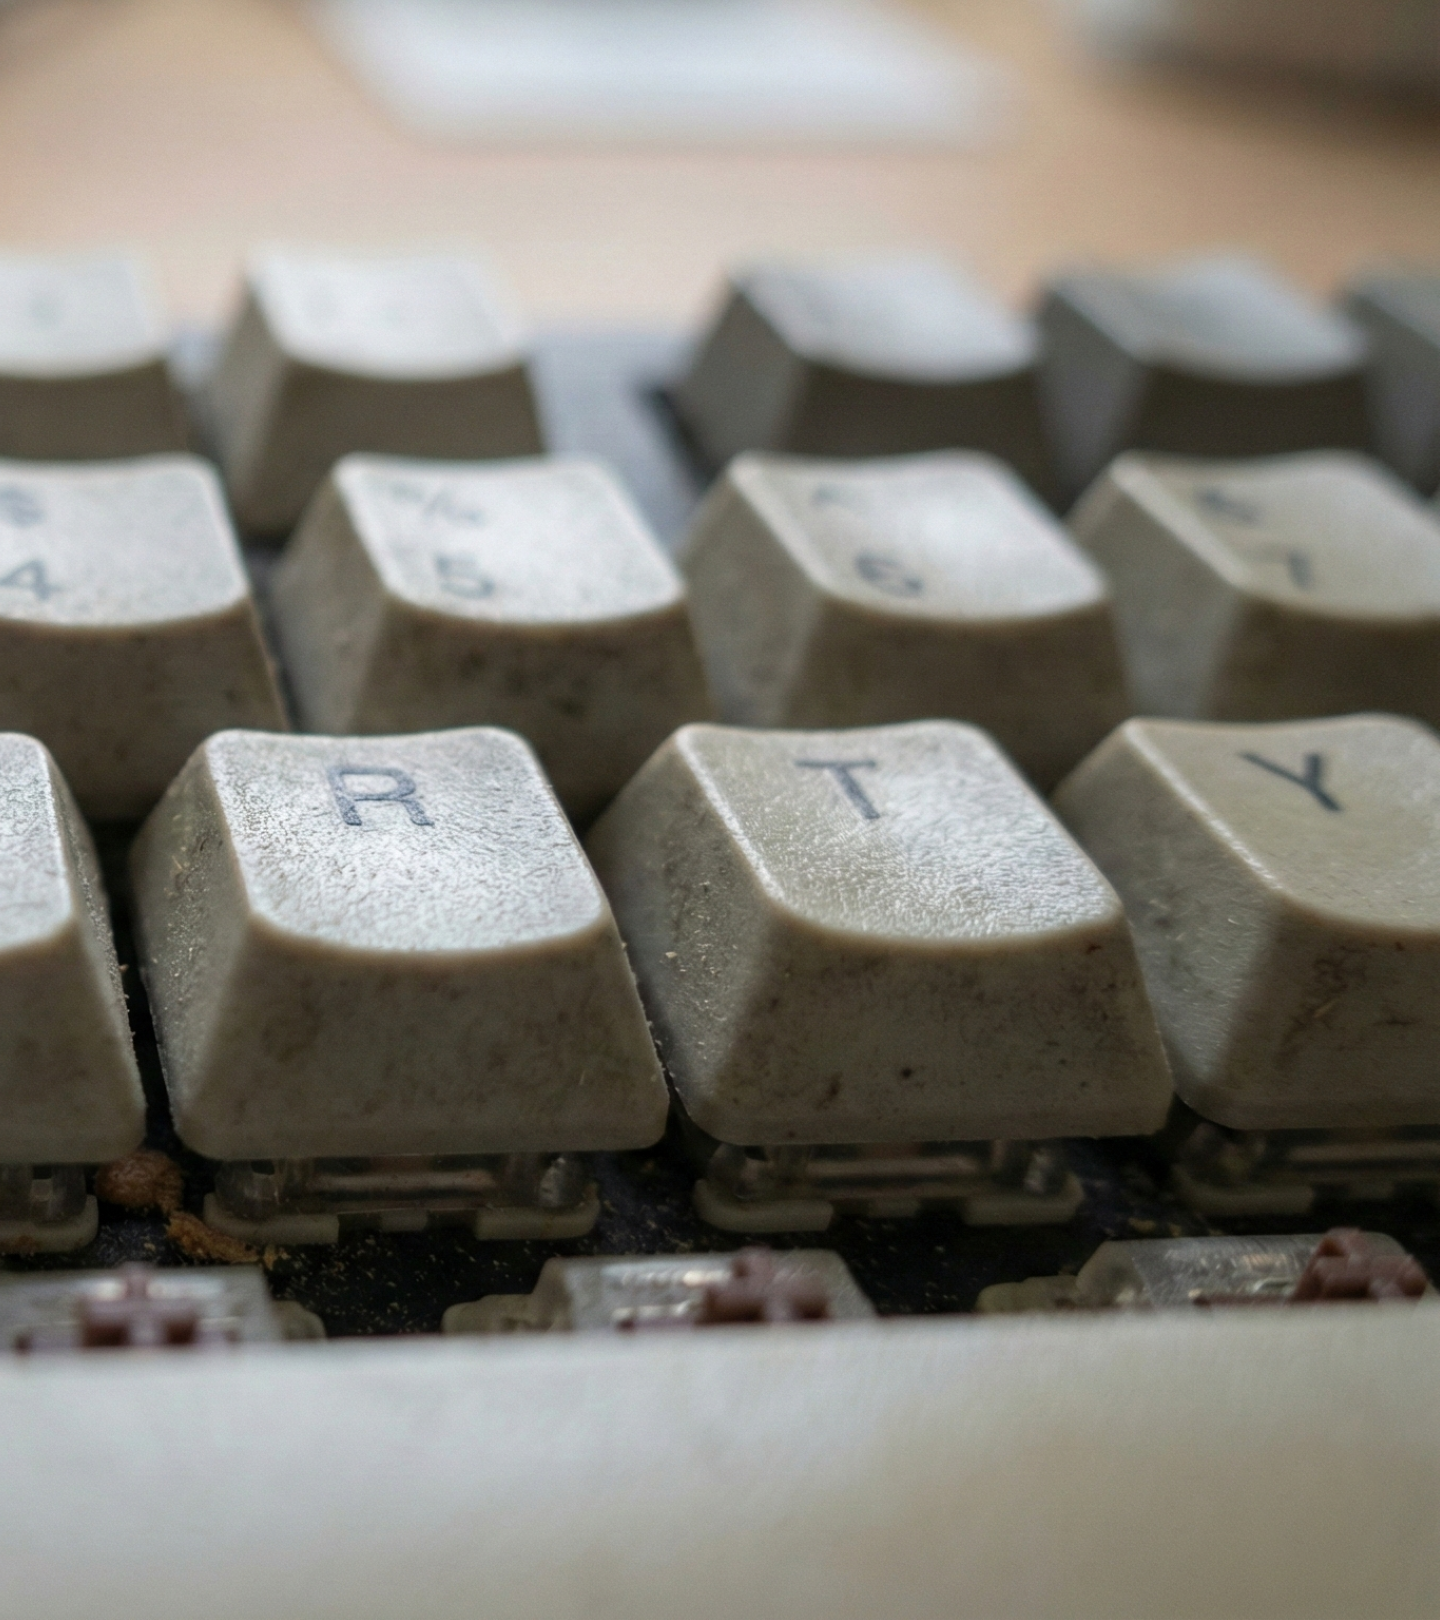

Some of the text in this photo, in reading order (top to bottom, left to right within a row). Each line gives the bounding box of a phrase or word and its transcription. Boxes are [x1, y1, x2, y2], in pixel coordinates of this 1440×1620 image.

[432, 552, 498, 600] 5
[852, 550, 924, 598] 6
[330, 768, 428, 829] R
[796, 758, 880, 822] T
[1240, 752, 1342, 812] Y
